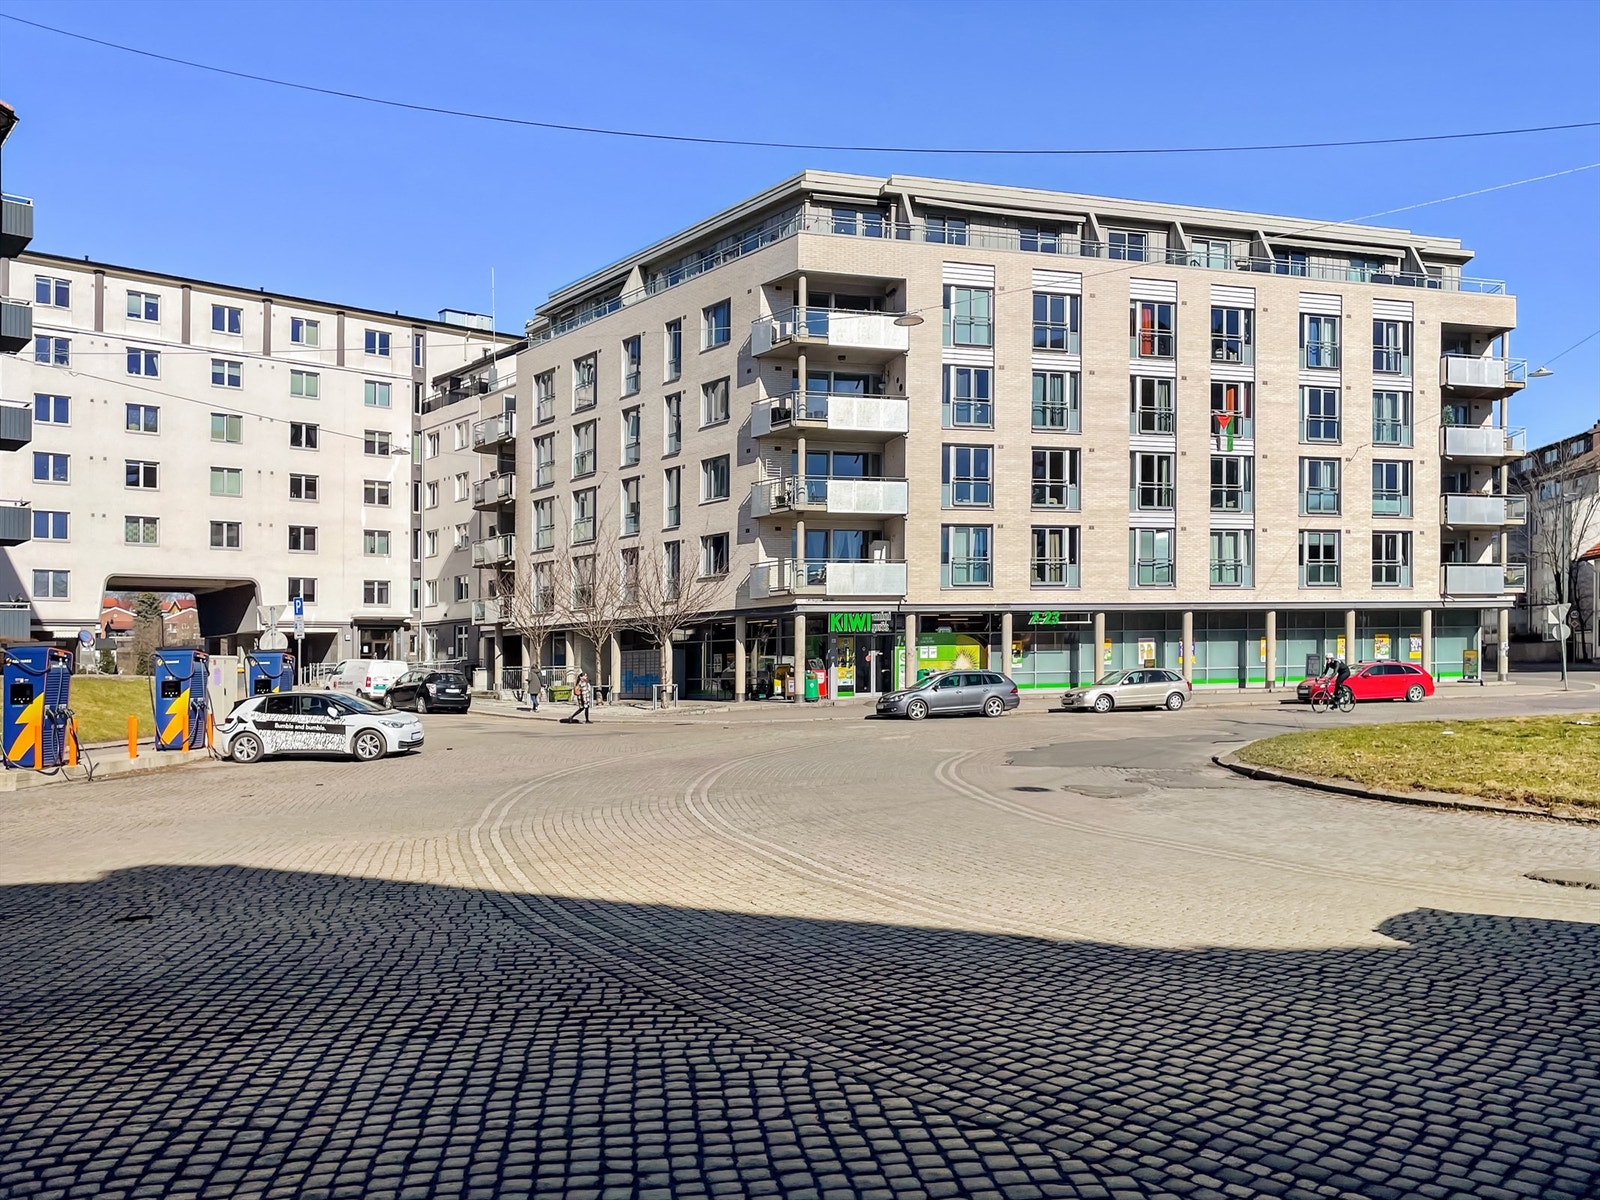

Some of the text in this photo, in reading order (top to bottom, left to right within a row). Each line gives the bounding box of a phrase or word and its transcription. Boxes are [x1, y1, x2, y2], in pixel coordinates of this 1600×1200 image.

[296, 600, 301, 614] P
[831, 612, 871, 632] KIWI
[1029, 611, 1060, 625] 7-23
